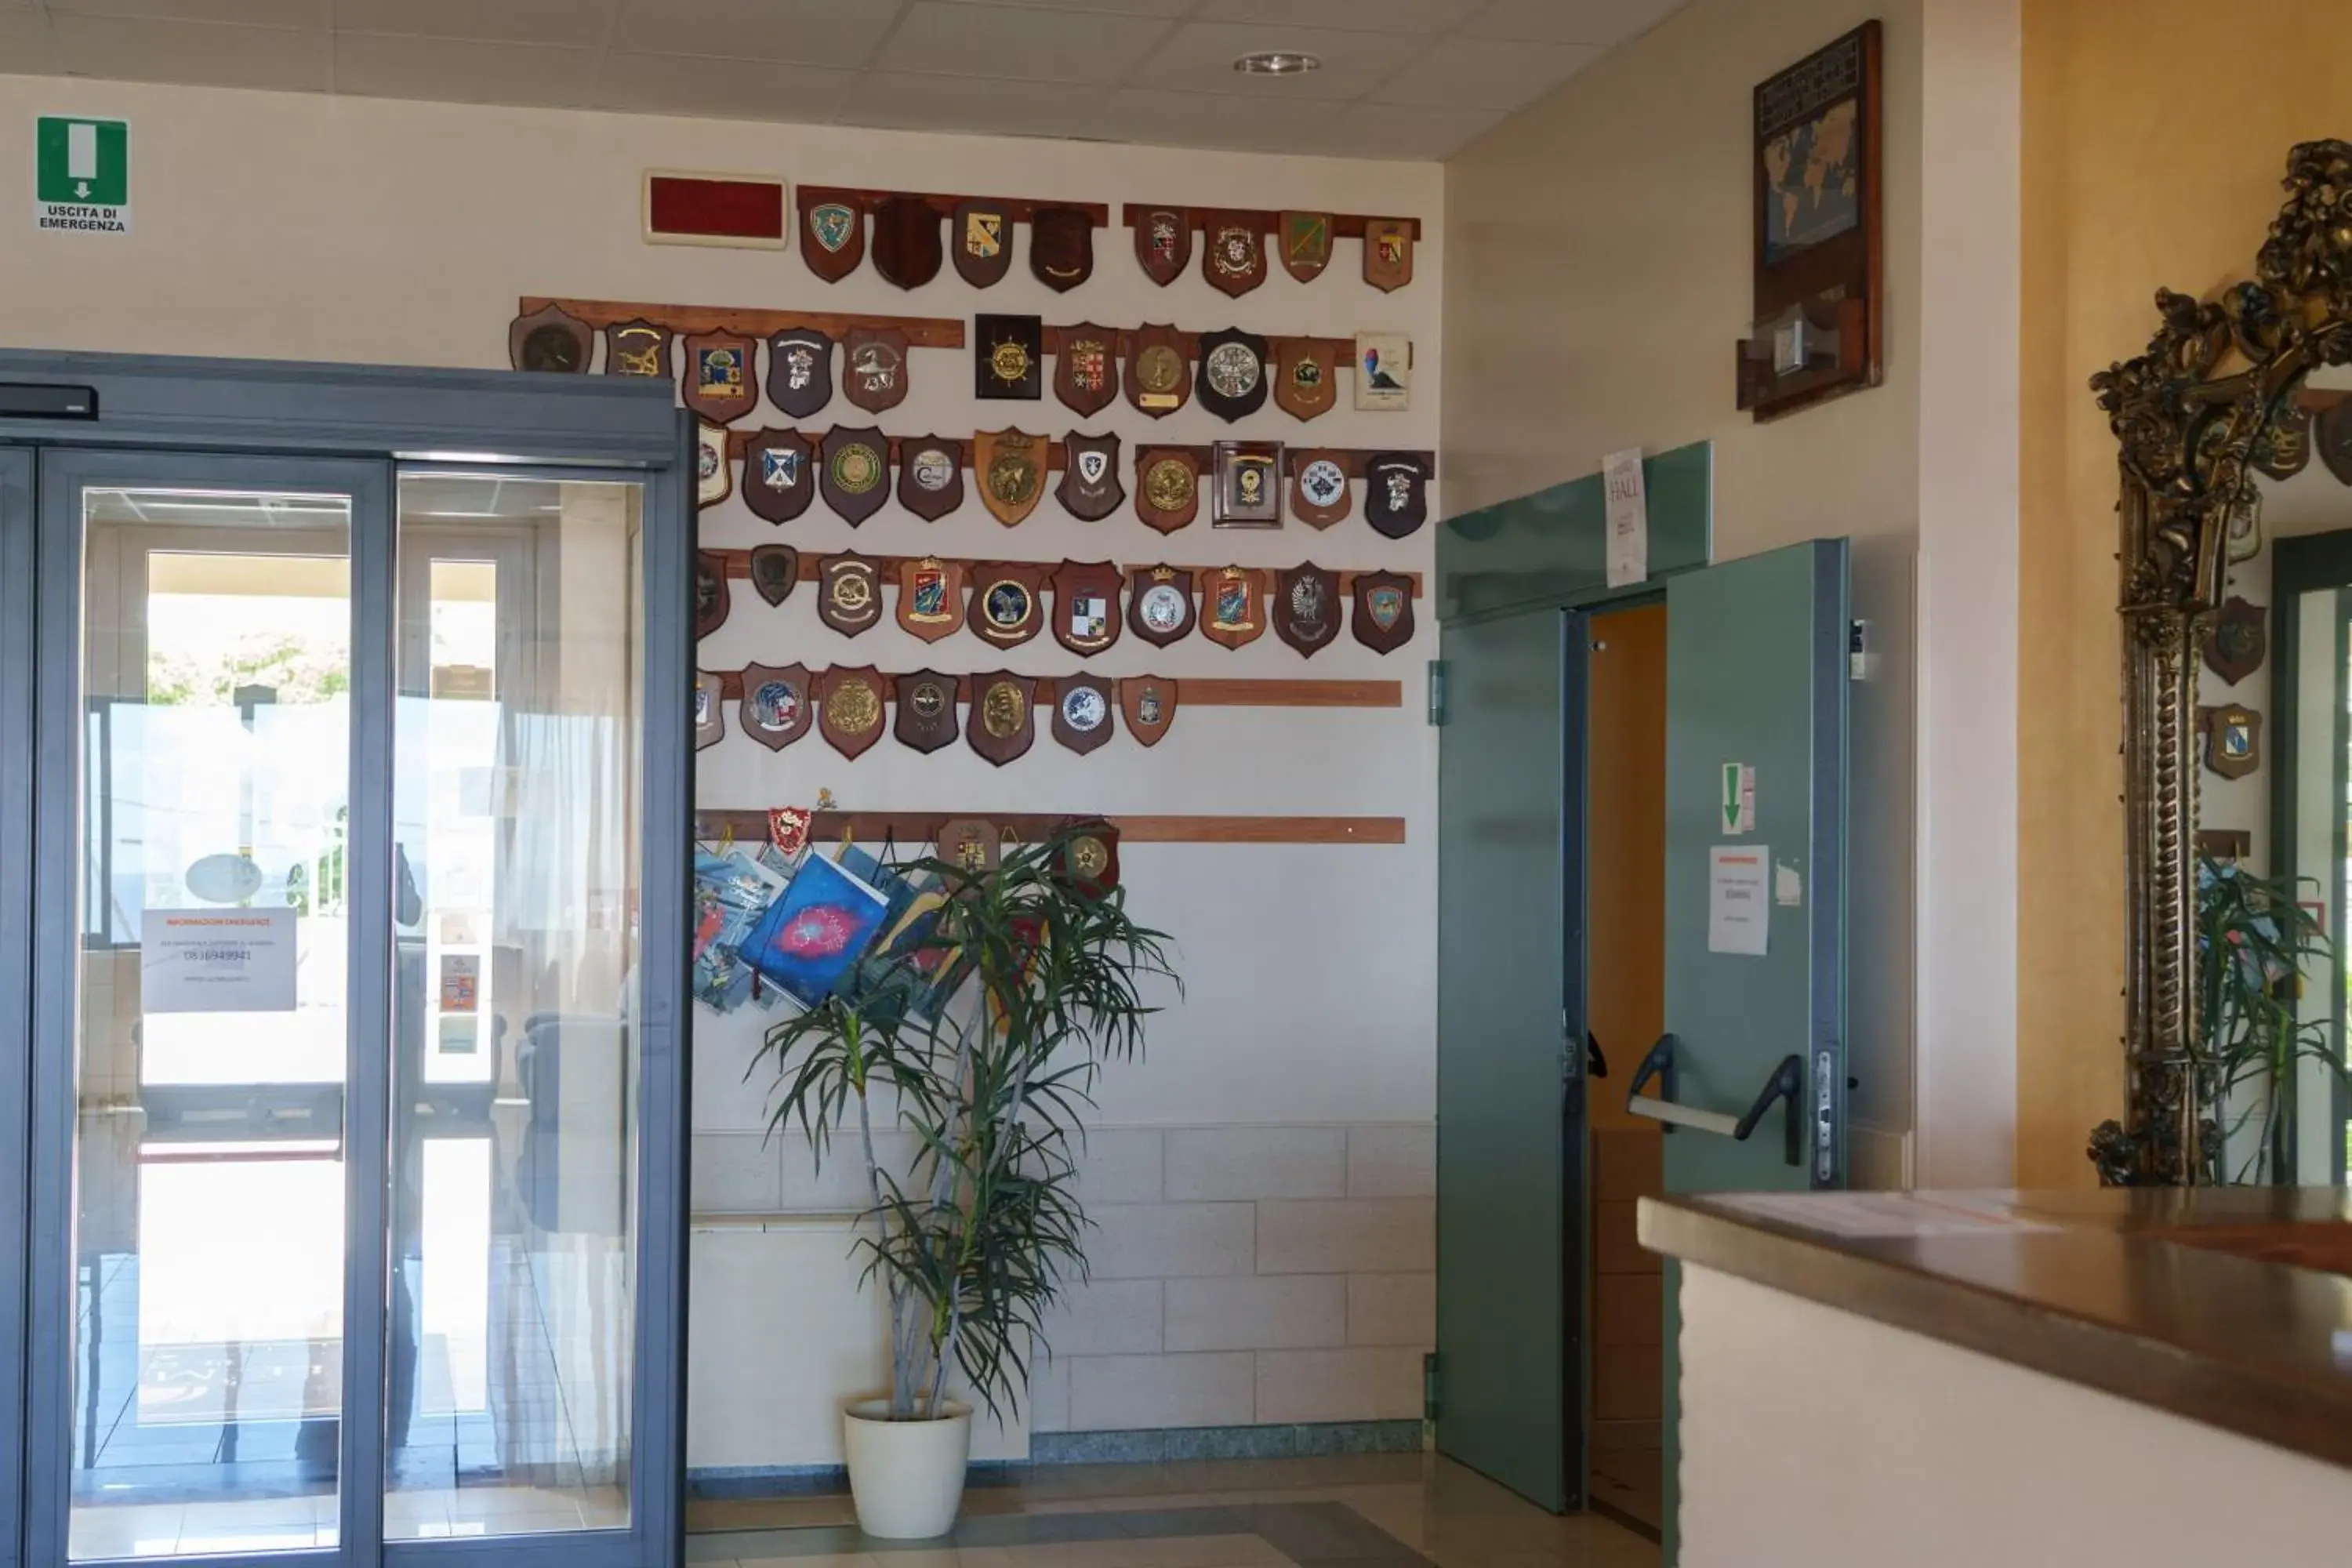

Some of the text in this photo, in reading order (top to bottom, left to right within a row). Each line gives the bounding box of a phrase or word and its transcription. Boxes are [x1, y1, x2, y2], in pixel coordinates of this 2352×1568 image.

[48, 205, 117, 218] USCITA DI
[39, 217, 125, 232] EMERGENZA
